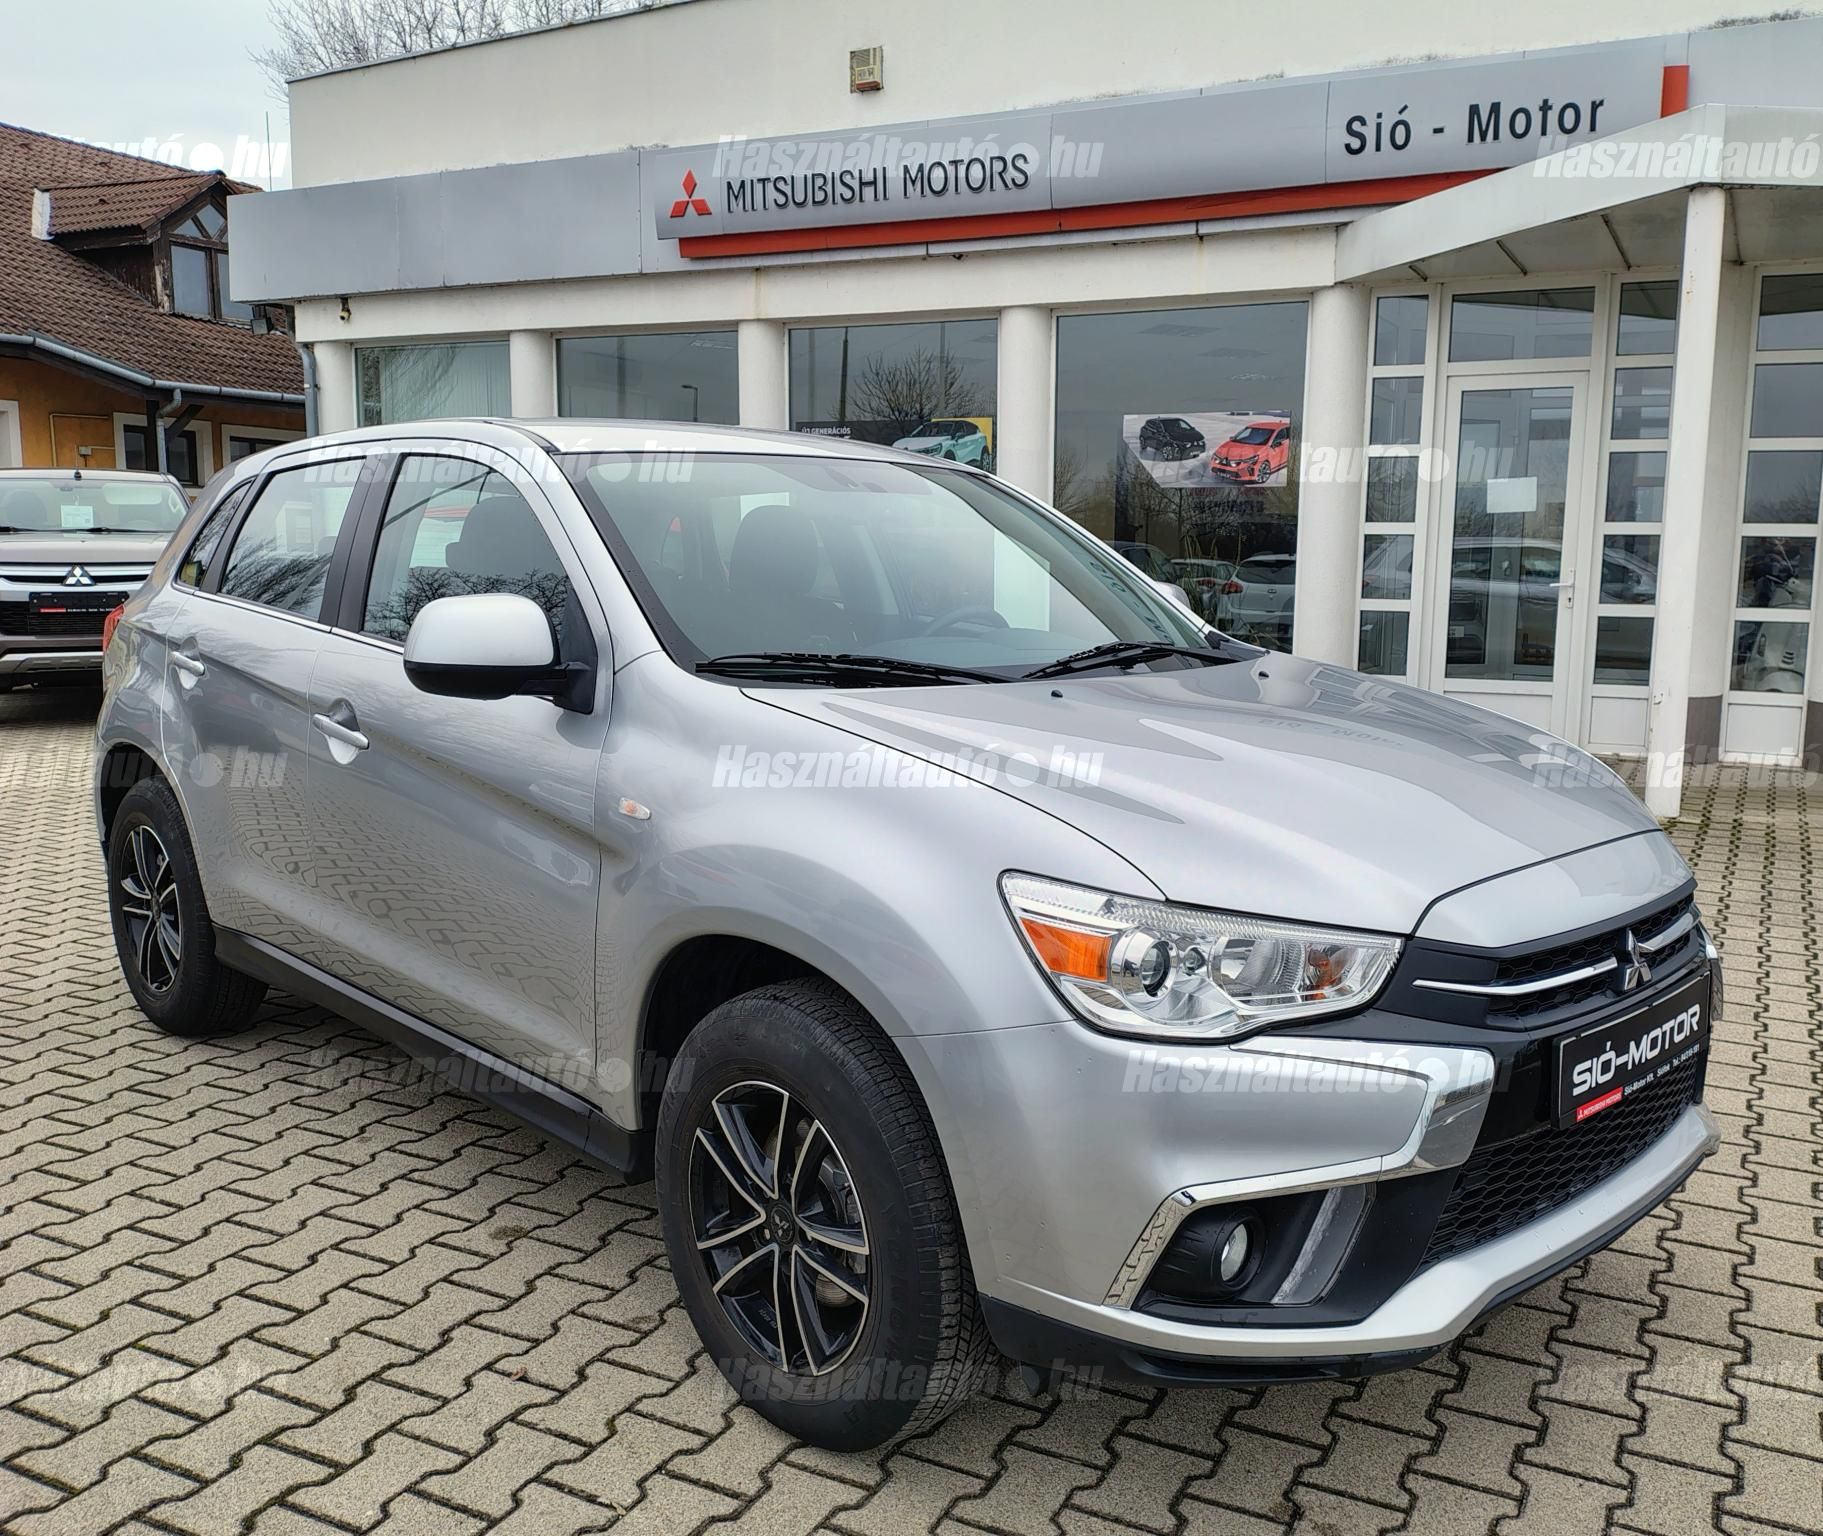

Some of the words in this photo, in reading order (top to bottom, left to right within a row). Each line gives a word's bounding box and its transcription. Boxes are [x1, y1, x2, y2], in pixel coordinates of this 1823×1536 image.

[1344, 104, 1412, 155] Sió
[1466, 98, 1605, 144] Motor
[726, 165, 890, 213] MITSUBISHI
[903, 153, 1030, 198] MOTORS
[811, 426, 851, 436] GENERÁCIÓS
[1572, 1004, 1701, 1097] SIÓ-MOTOR
